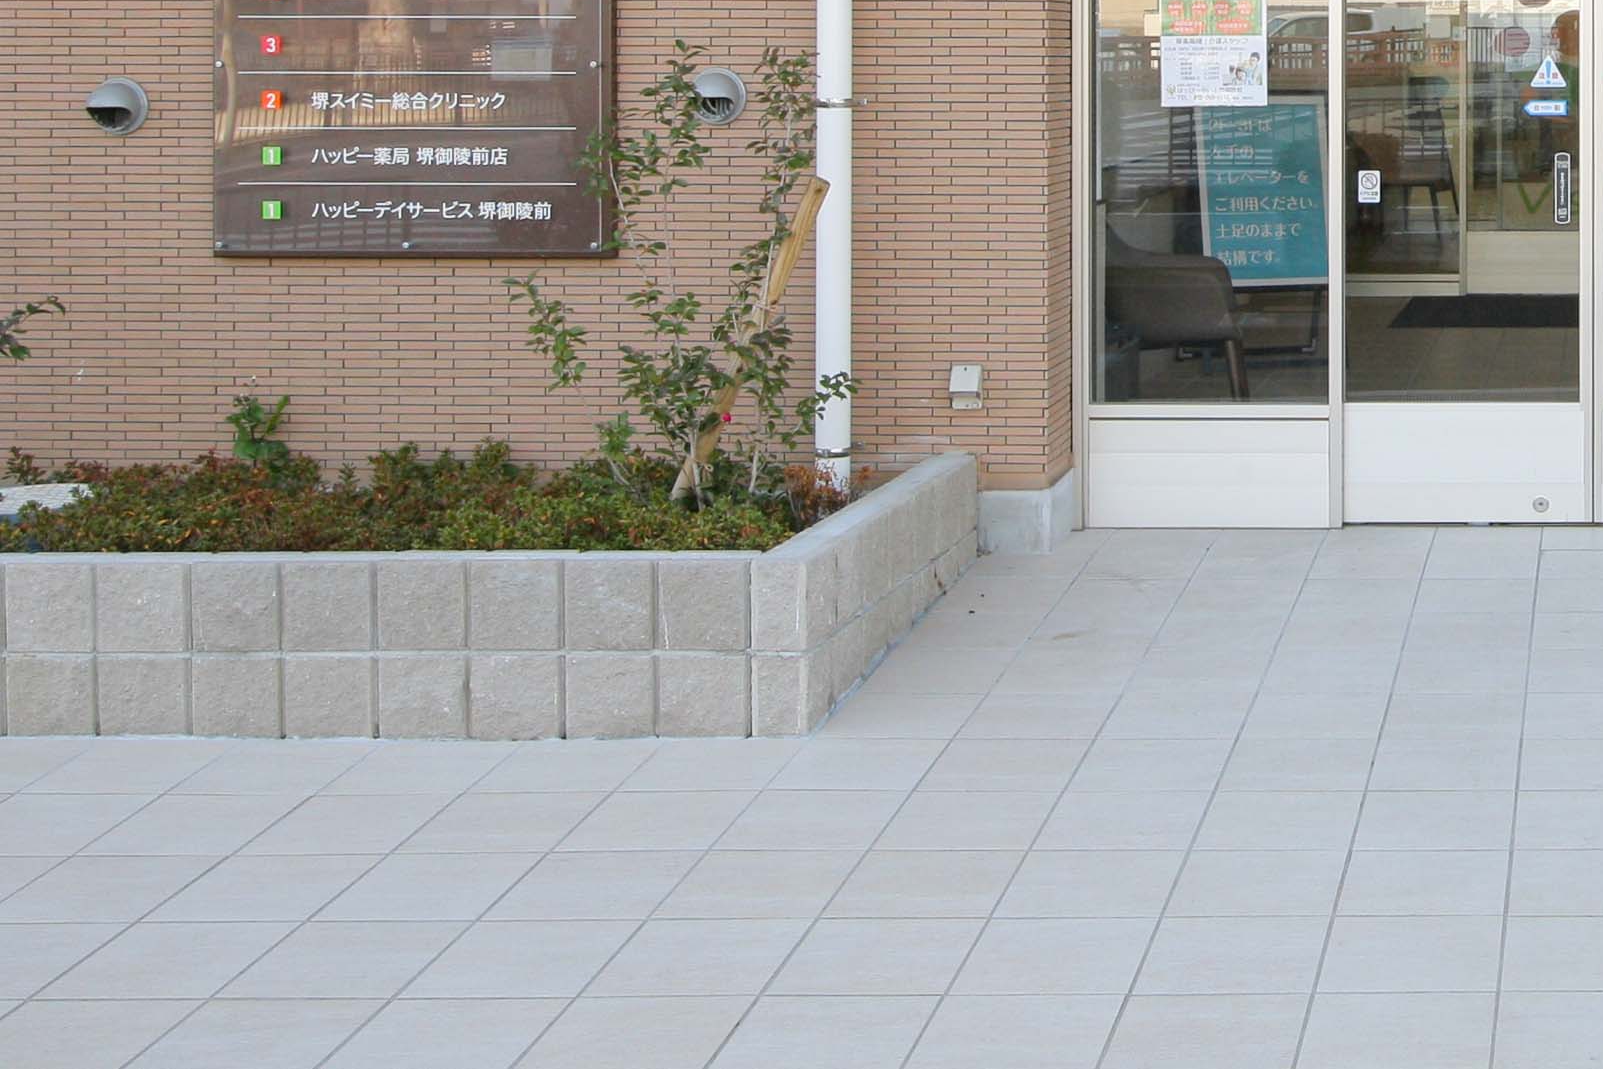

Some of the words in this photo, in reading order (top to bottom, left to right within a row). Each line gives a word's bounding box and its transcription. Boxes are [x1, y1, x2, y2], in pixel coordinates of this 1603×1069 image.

[311, 92, 506, 110] 堺スイミー総合クリニック
[311, 147, 410, 166] ハッピー薬局
[416, 147, 508, 166] 堺御陵前店
[311, 201, 474, 220] ハッピーデイサービス
[478, 201, 552, 221] 堺御陵前
